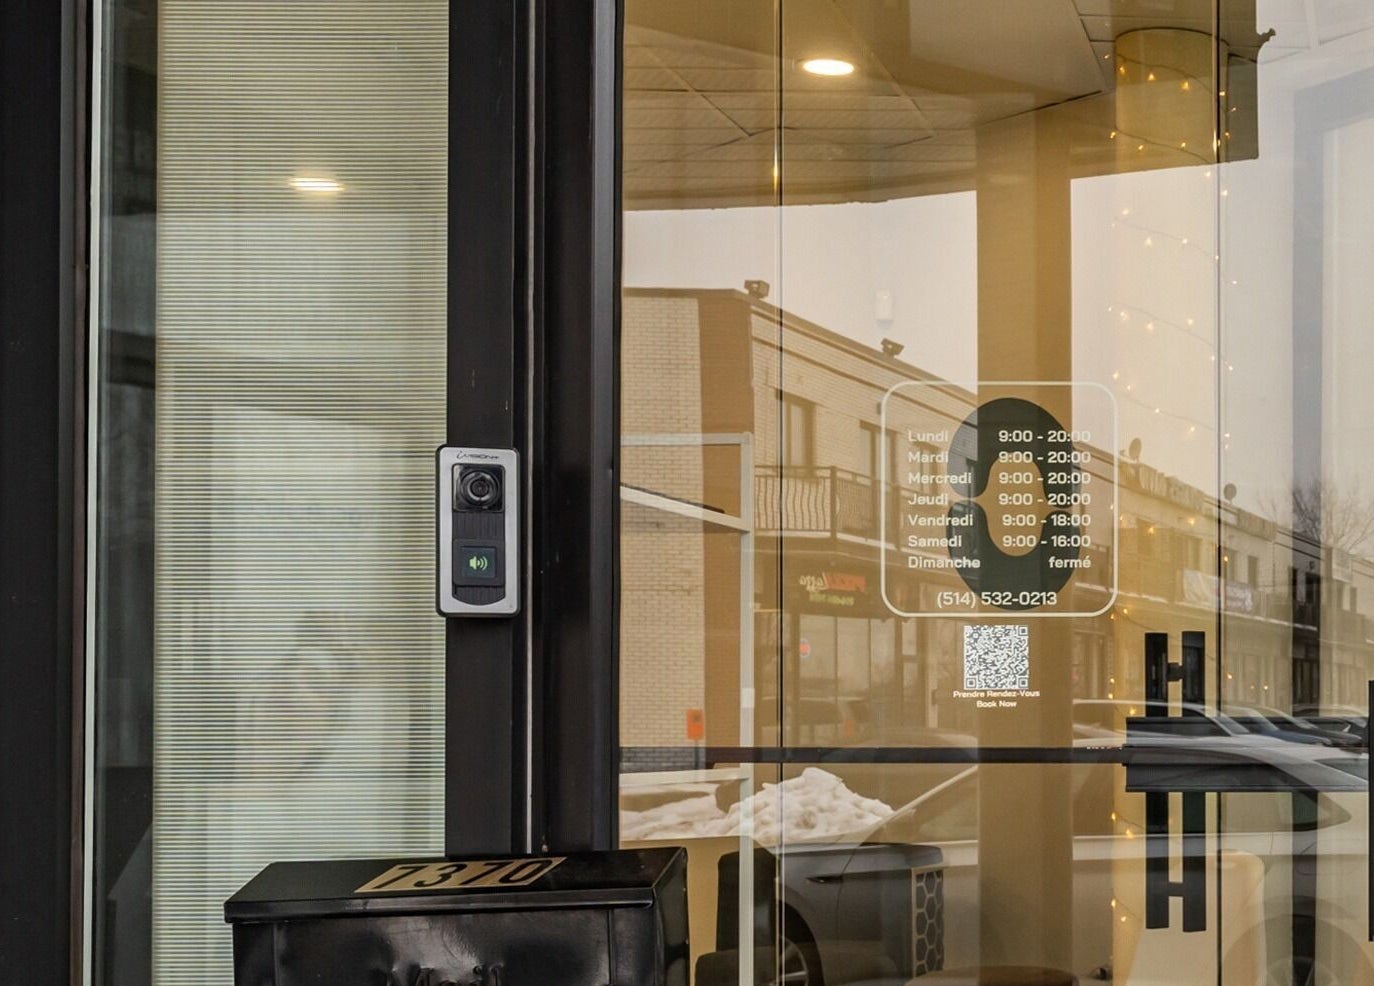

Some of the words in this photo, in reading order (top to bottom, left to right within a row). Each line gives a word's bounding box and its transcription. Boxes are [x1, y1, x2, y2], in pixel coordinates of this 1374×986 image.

[907, 430, 949, 442] Lundi
[999, 430, 1033, 442] 9:00
[1047, 430, 1091, 442] 20:00
[907, 451, 949, 463] Mardi
[999, 451, 1033, 463] 9:00
[1047, 451, 1091, 463] 20:00
[907, 472, 972, 484] Mercredi
[999, 472, 1033, 484] 9:00
[1047, 472, 1091, 484] 20:00
[907, 493, 949, 505] Jeudi
[999, 493, 1033, 505] 9:00
[1047, 493, 1091, 505] 20:00
[907, 514, 974, 526] Vendredi
[1002, 514, 1036, 526] 9:00
[1051, 514, 1091, 526] 18:00
[907, 535, 962, 547] Samedi
[1002, 535, 1036, 547] 9:00
[1051, 535, 1091, 547] 16:00
[907, 556, 981, 569] Dimanche
[1048, 556, 1092, 569] fermé
[937, 591, 976, 608] (514)
[981, 591, 1057, 606] 532-0213
[987, 690, 1040, 698] Rendez-Vous
[371, 859, 554, 890] 7370
